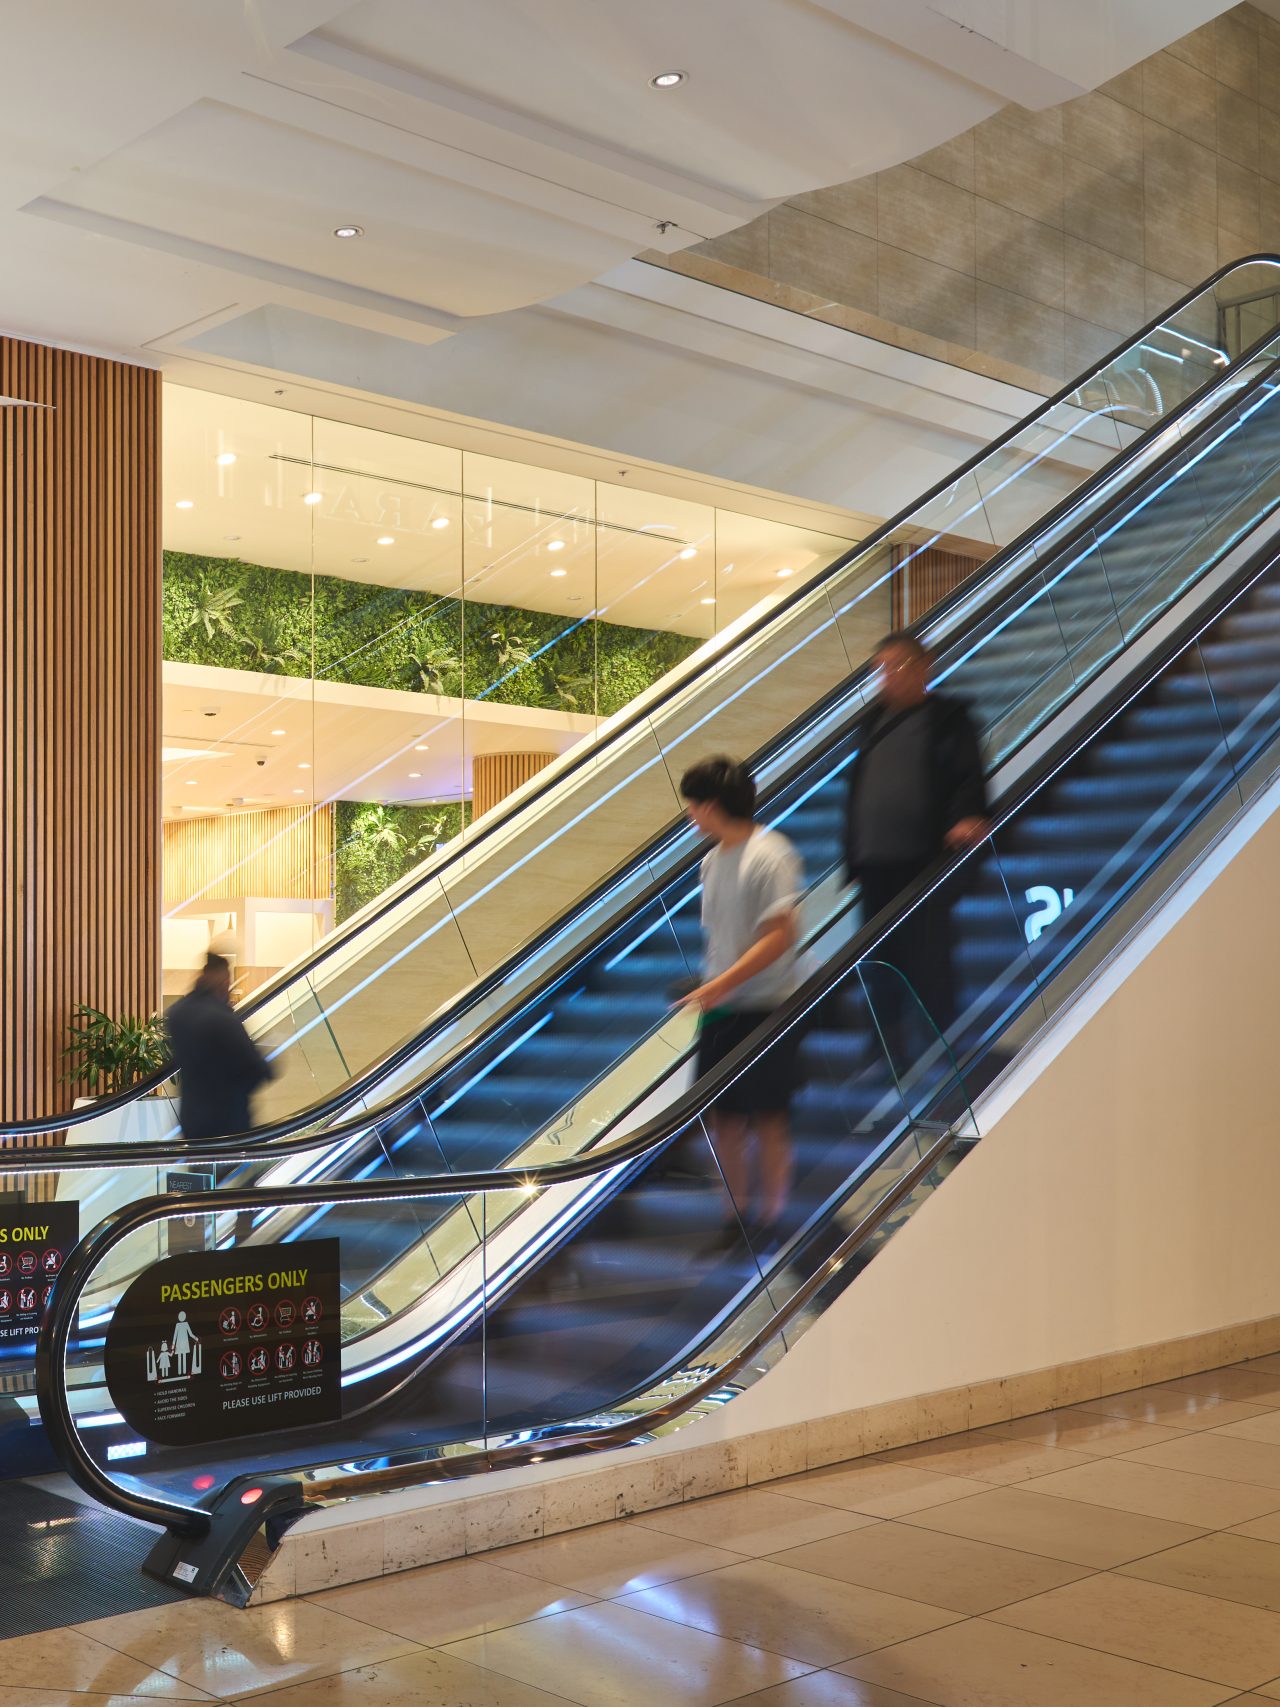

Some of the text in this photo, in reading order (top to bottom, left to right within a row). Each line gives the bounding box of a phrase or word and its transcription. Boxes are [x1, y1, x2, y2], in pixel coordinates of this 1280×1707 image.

[12, 1226, 49, 1242] ONLY
[161, 1269, 308, 1302] PASSENGERS ONLY
[10, 1327, 24, 1336] LIFT
[222, 1386, 322, 1410] PLEASE USE LIFT PROVIDED
